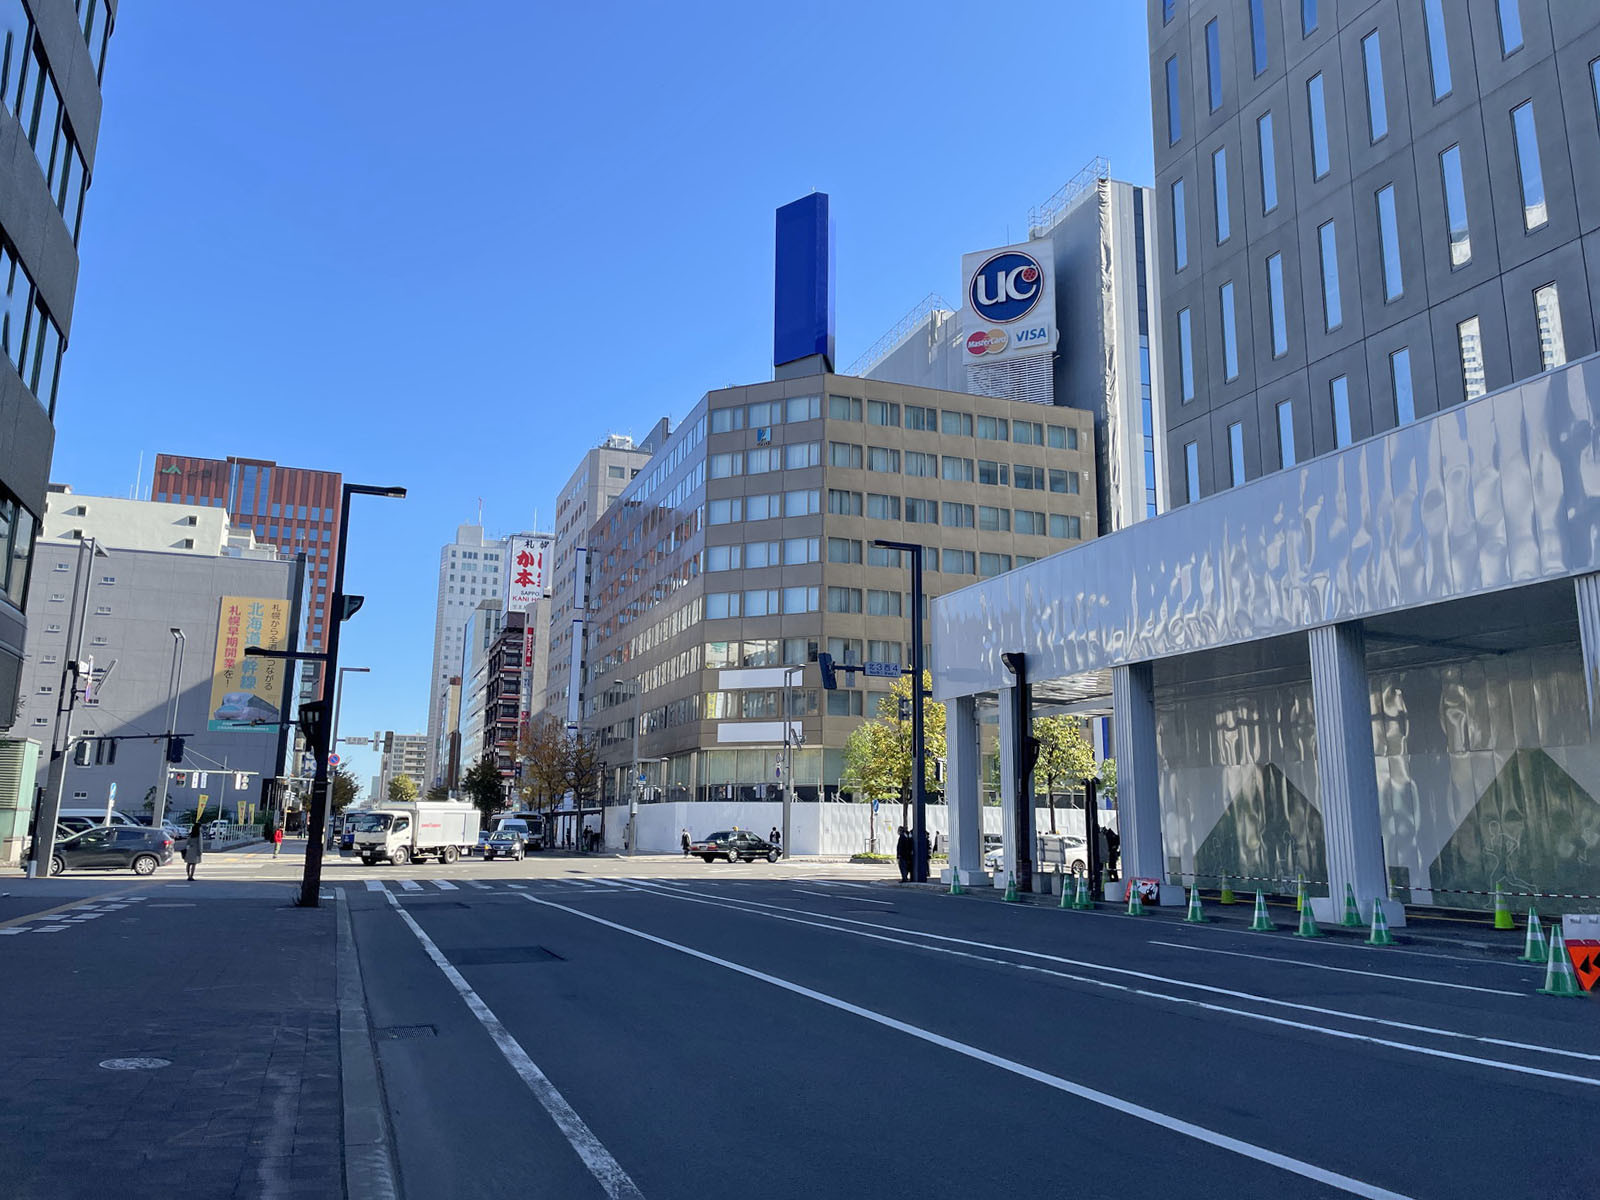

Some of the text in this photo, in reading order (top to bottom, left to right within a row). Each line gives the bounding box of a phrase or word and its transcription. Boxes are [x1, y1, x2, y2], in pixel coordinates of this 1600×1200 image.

[968, 336, 1007, 348] MasterCard
[1016, 327, 1047, 342] VISA
[241, 602, 264, 690] 北海道幹線
[264, 603, 282, 691] 札幌から全道つながる
